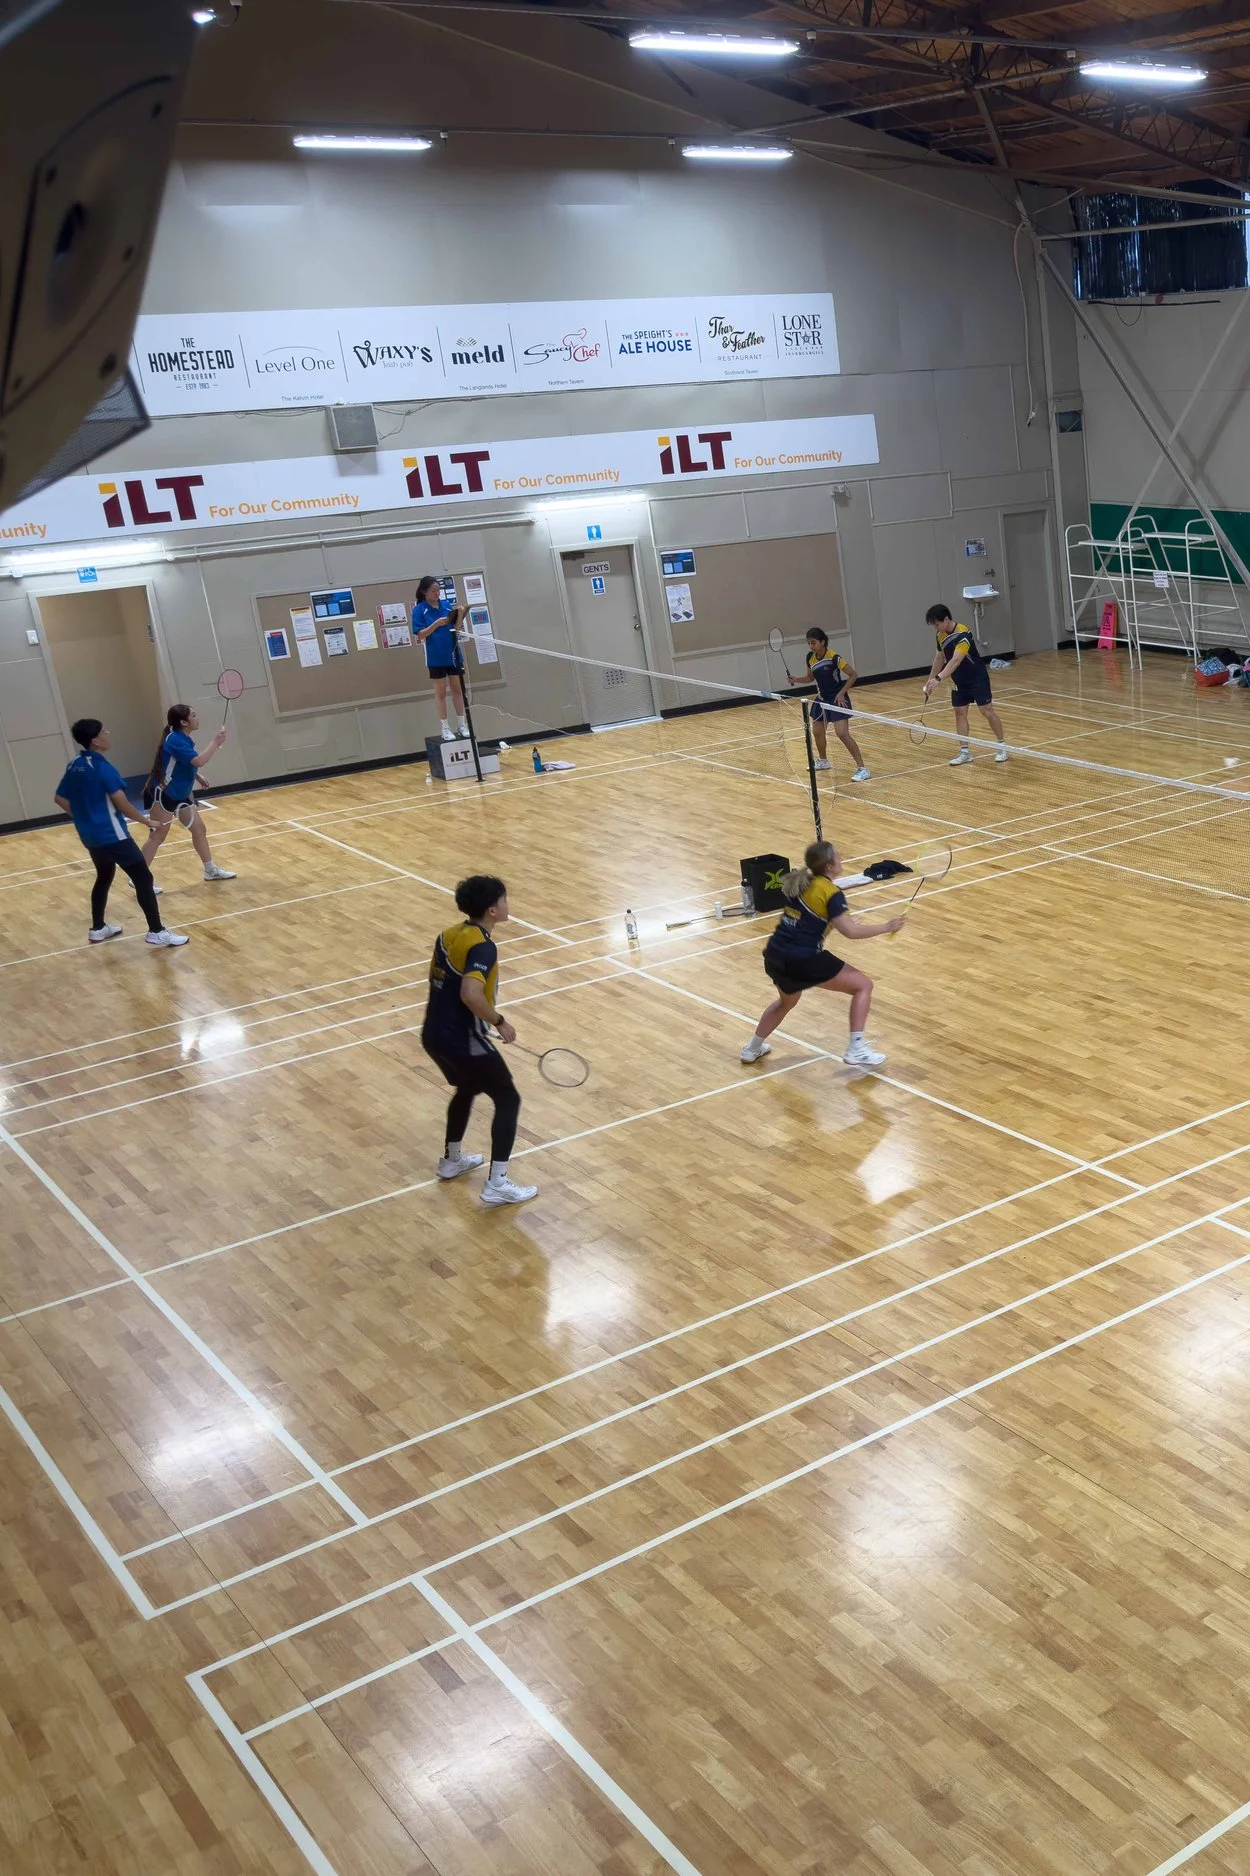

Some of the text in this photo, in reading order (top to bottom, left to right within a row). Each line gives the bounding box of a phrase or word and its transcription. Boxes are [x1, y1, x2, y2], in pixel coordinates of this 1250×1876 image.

[782, 314, 822, 330] LONE
[181, 338, 195, 348] THE
[634, 329, 673, 340] SPEIGHT'S
[353, 340, 433, 369] WAXY'S
[451, 344, 505, 365] meld
[523, 343, 600, 366] Saucy Chef
[619, 339, 692, 354] ALE HOUSE
[148, 349, 235, 373] HOMESTEAD
[255, 356, 335, 373] Level One
[734, 457, 752, 468] For
[755, 456, 775, 466] Our
[779, 450, 842, 463] Community
[494, 479, 514, 491] For
[518, 476, 542, 488] Our
[546, 469, 620, 485] Community
[209, 506, 234, 518] For
[238, 502, 267, 515] Our
[271, 493, 359, 511] Community
[583, 564, 609, 574] GENTS
